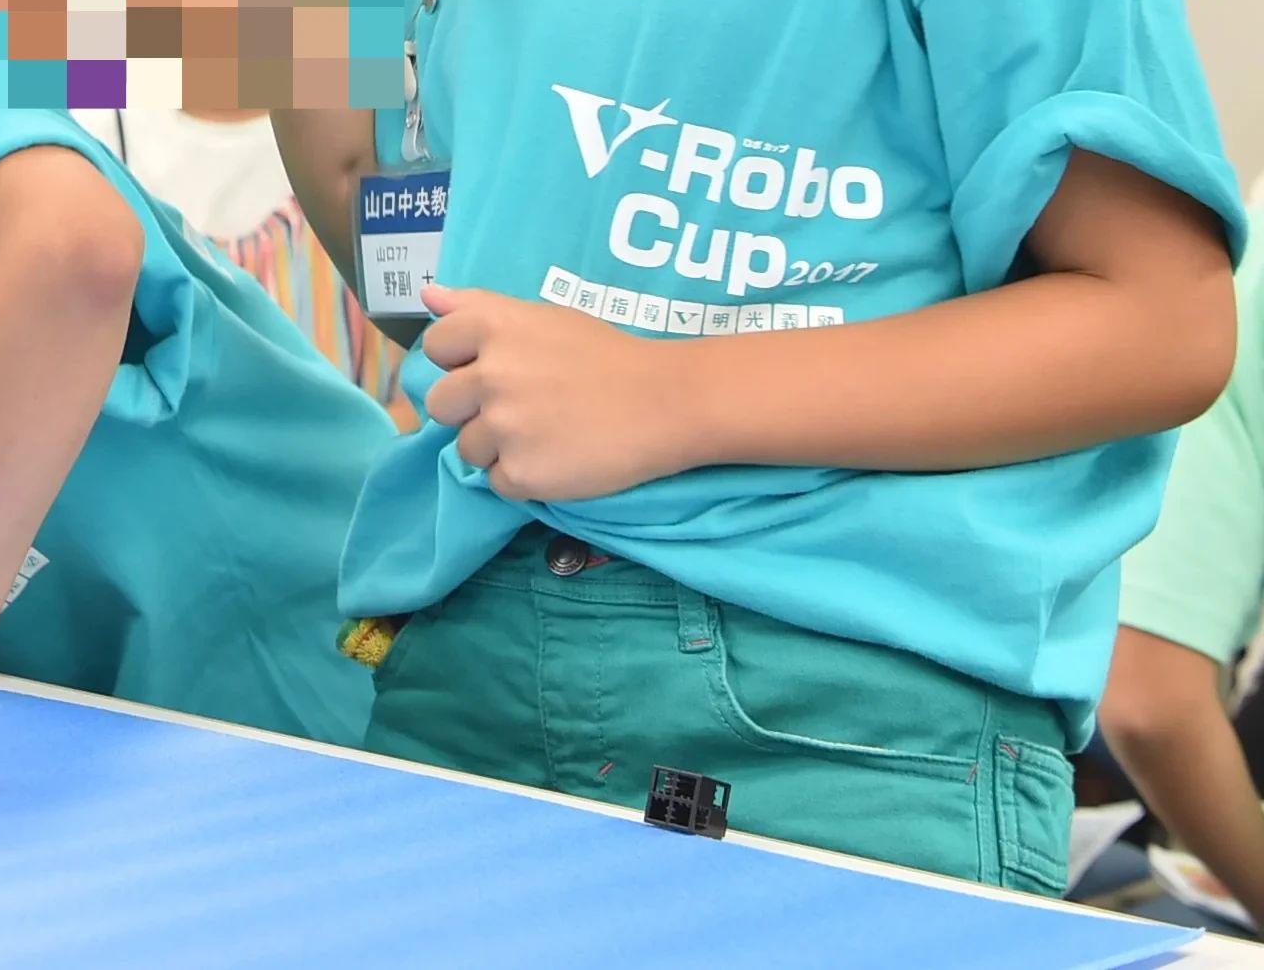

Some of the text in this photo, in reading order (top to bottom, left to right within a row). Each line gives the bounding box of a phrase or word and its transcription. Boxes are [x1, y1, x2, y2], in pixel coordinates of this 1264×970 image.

[364, 185, 451, 220] 山口中央教
[608, 192, 880, 297] Cup 2017
